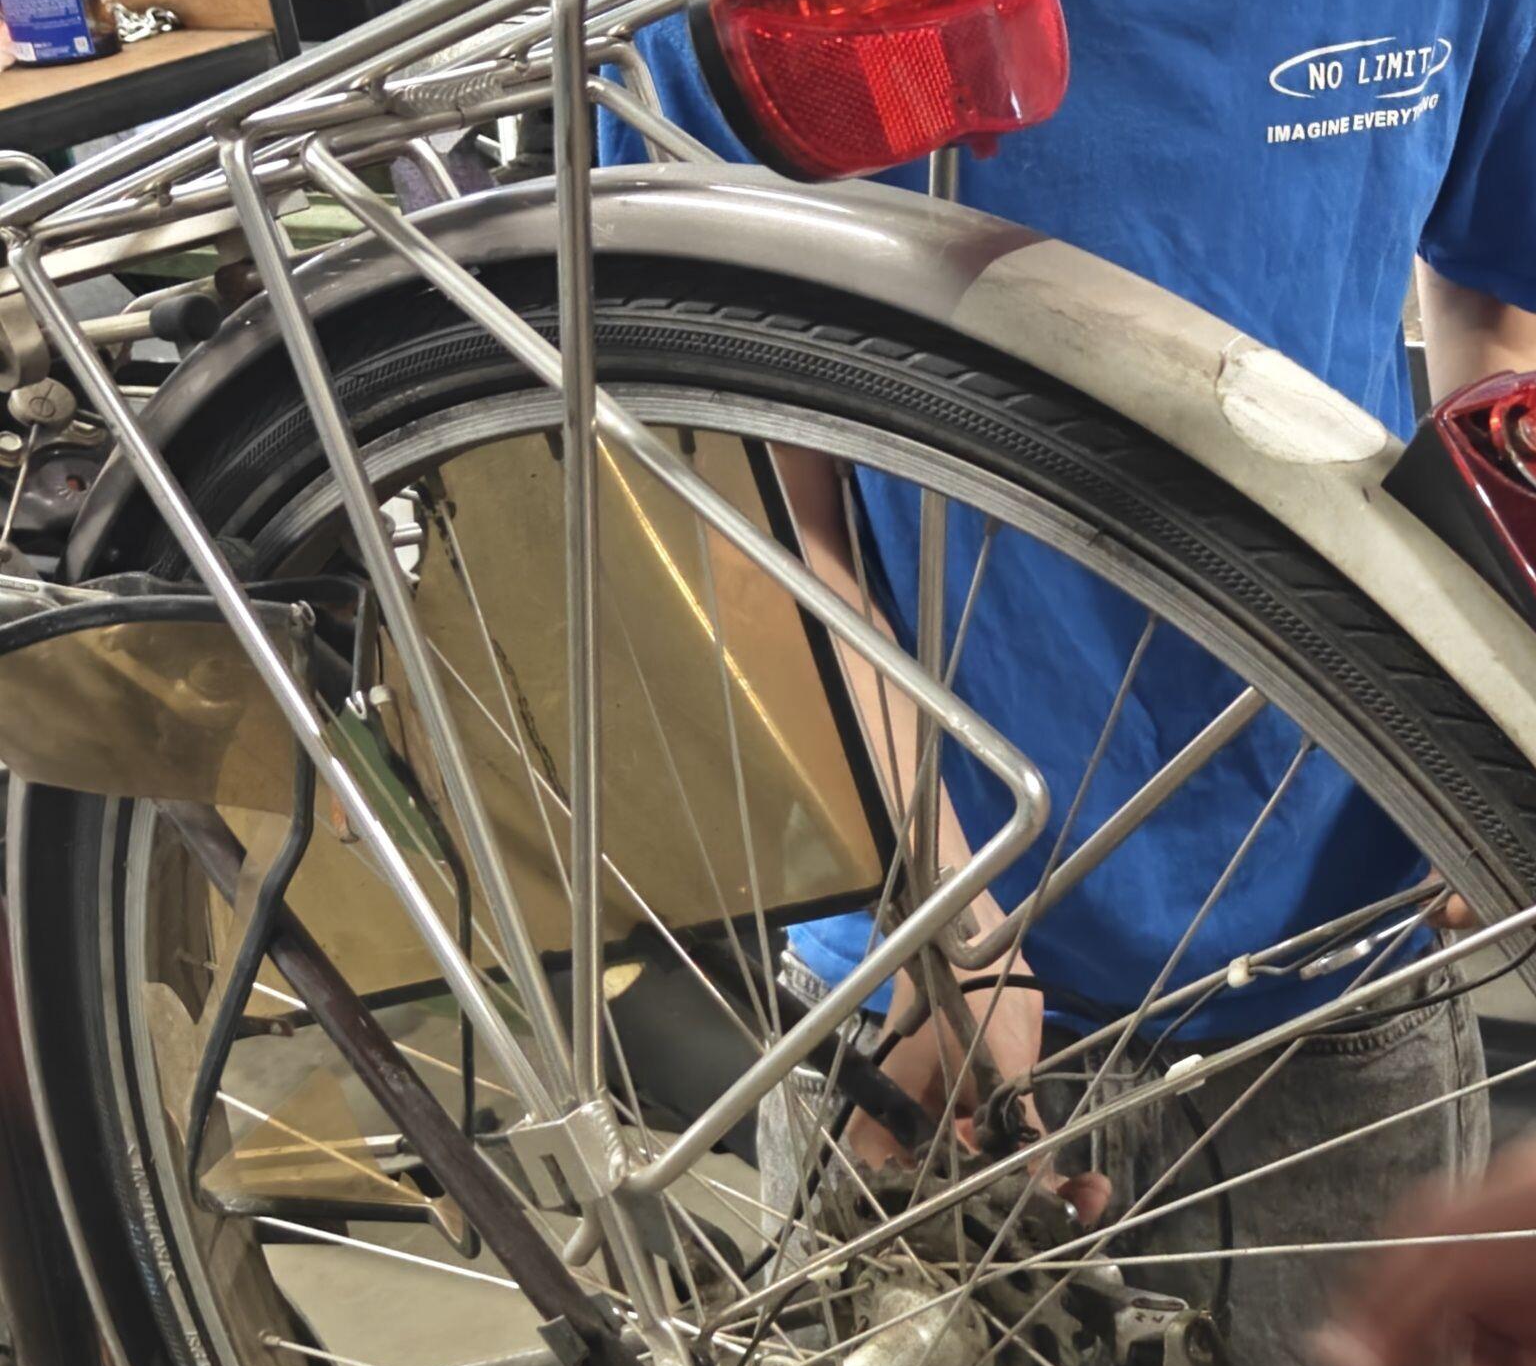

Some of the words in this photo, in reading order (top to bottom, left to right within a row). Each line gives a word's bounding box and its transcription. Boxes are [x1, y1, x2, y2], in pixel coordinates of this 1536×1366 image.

[1308, 61, 1343, 91] NO
[1358, 46, 1433, 84] LIMIT
[1266, 116, 1350, 144] IMAGINE
[1352, 93, 1440, 131] EVERYTNG
